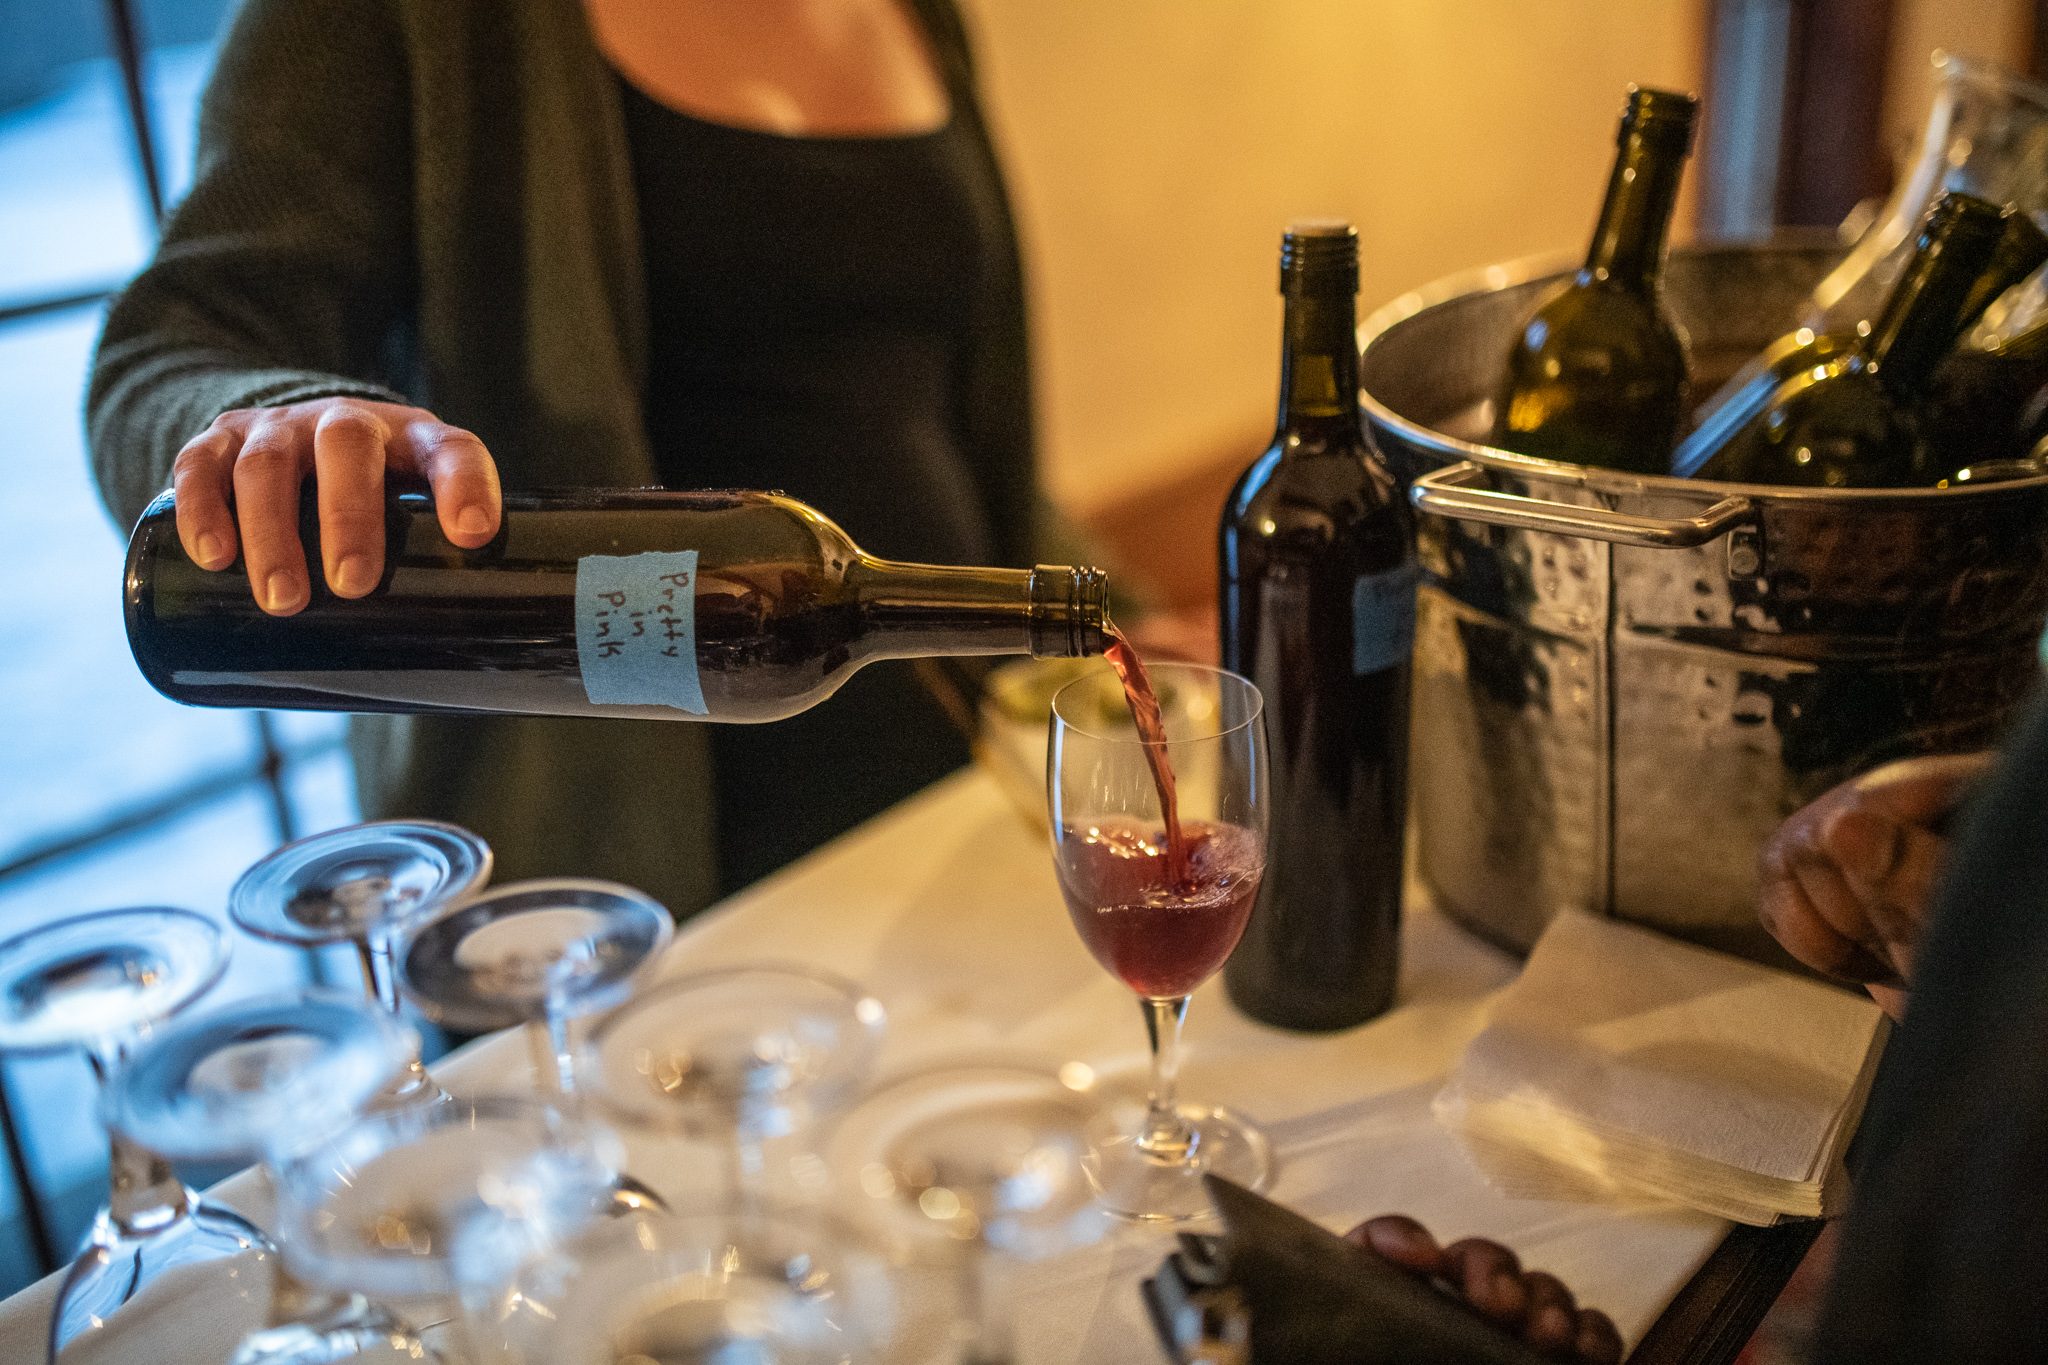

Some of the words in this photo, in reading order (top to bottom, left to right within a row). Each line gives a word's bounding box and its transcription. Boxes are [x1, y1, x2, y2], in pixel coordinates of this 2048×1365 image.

[596, 592, 626, 658] Pink
[629, 611, 652, 637] in
[656, 573, 689, 657] Pretty
